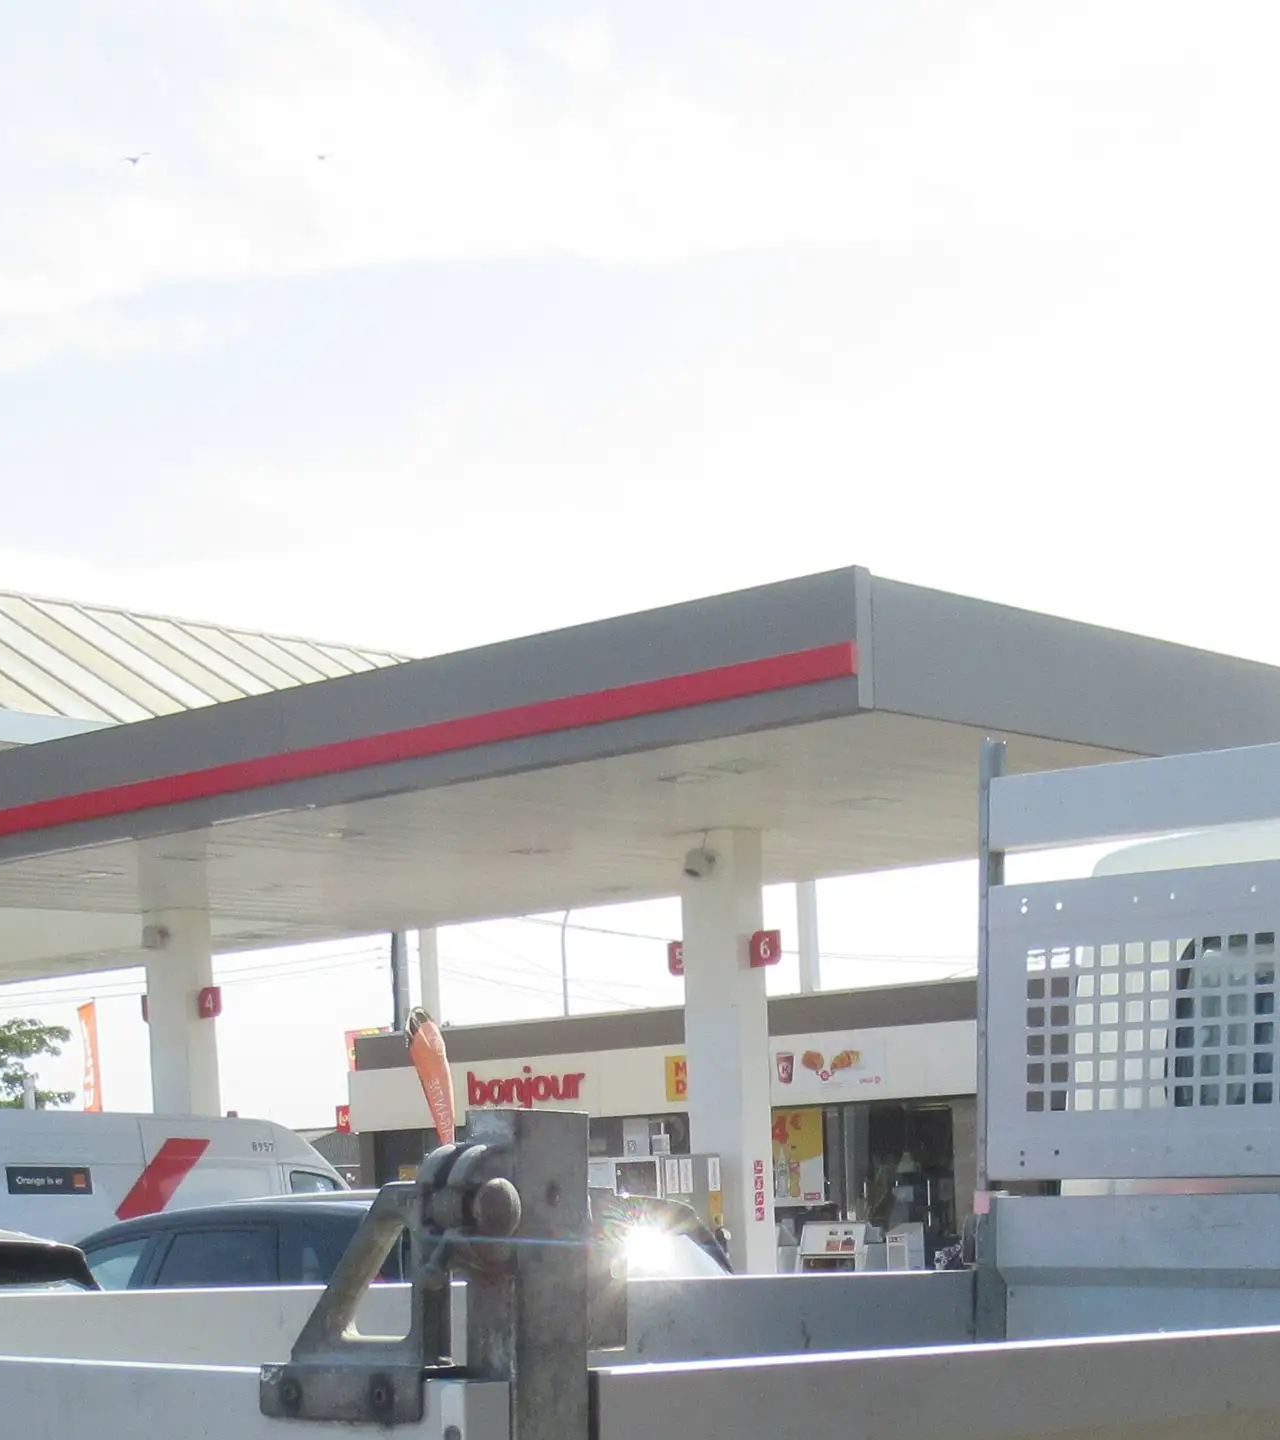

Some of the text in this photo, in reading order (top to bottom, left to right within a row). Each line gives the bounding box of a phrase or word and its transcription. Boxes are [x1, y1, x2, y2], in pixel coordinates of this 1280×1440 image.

[760, 938, 770, 959] 6
[204, 992, 214, 1013] 4
[467, 1065, 585, 1108] bonjour
[251, 1141, 274, 1152] 8957
[16, 1175, 45, 1187] Orange
